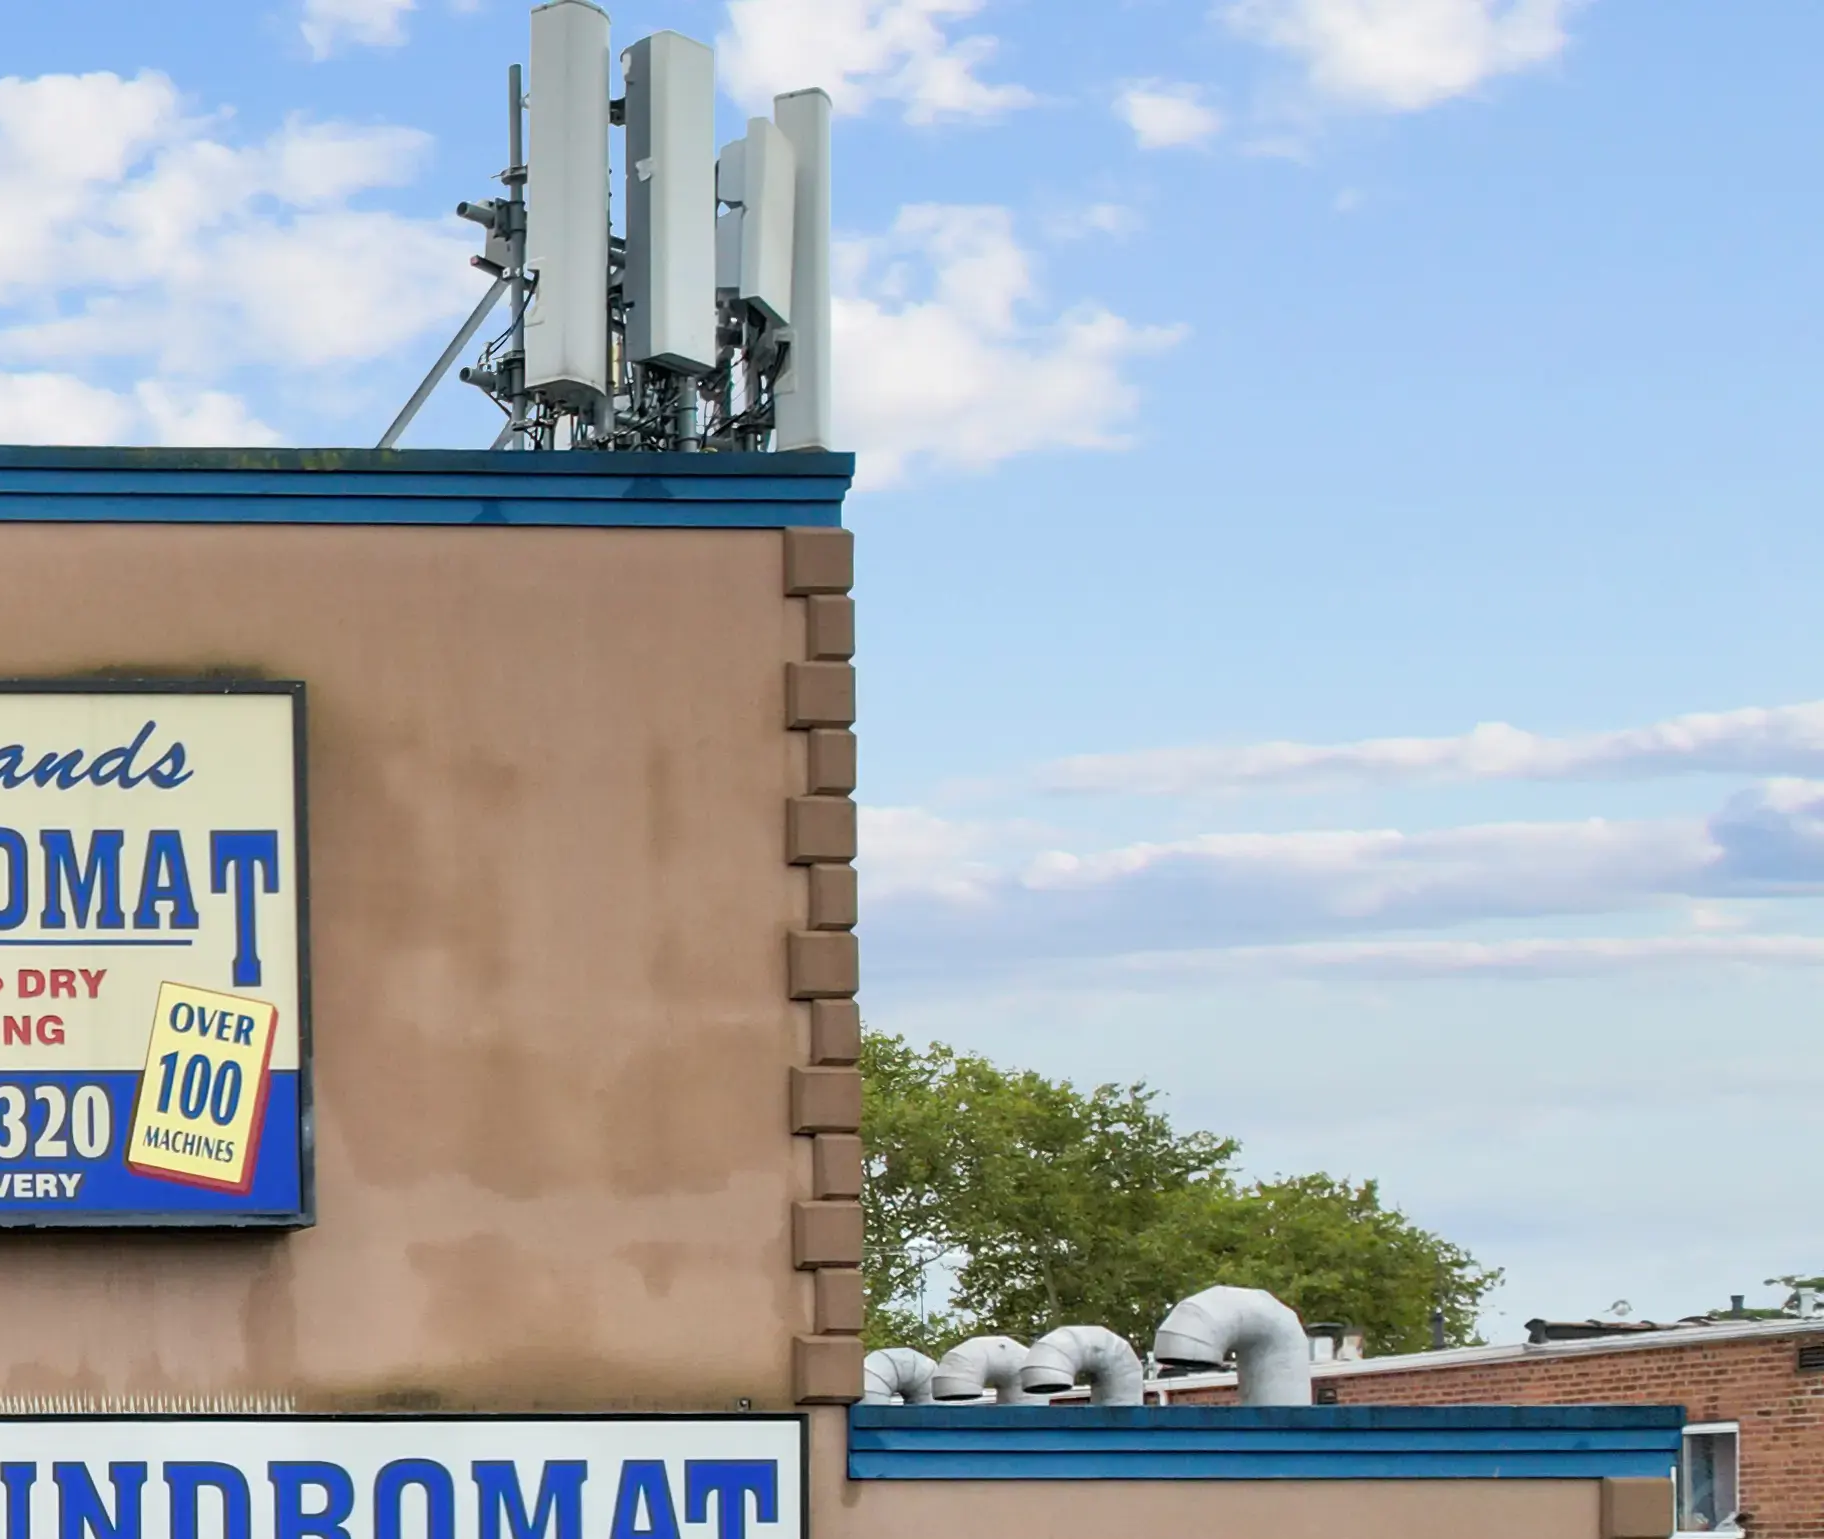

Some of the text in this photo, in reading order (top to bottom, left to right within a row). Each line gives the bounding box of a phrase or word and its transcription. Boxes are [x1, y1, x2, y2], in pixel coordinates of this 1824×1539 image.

[17, 968, 108, 1000] DRY
[168, 1002, 256, 1047] OVER
[156, 1050, 243, 1127] 100
[141, 1124, 236, 1165] MACHINES
